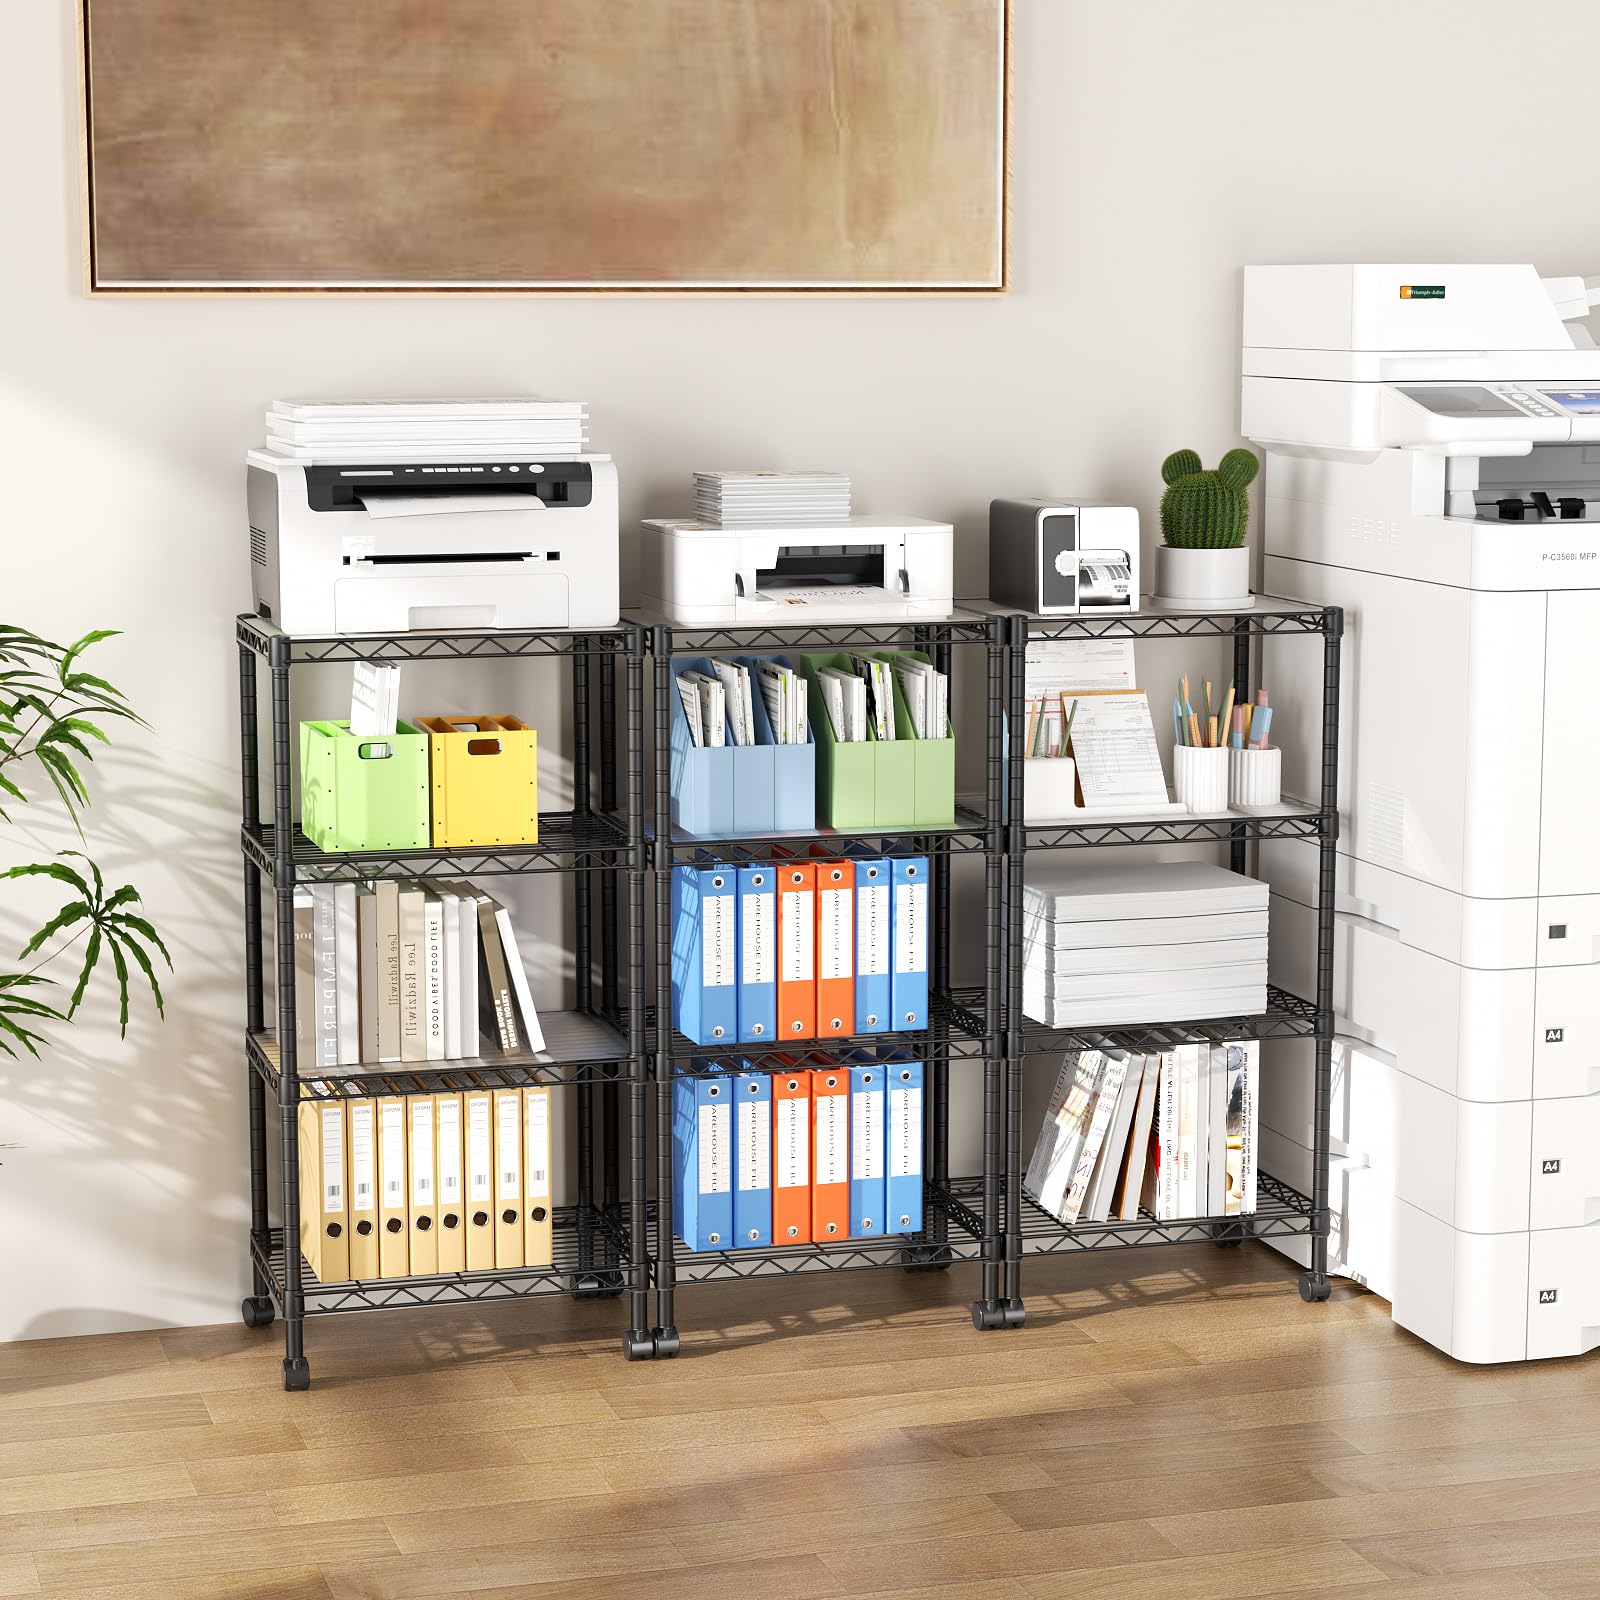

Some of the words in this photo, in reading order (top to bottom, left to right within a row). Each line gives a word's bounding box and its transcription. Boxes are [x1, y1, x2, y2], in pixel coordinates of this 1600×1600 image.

[1542, 552, 1578, 561] P-C3560i
[1580, 552, 1597, 560] MFP
[1546, 1030, 1560, 1040] A4
[1544, 1161, 1557, 1171] A4
[1541, 1291, 1554, 1301] A4
